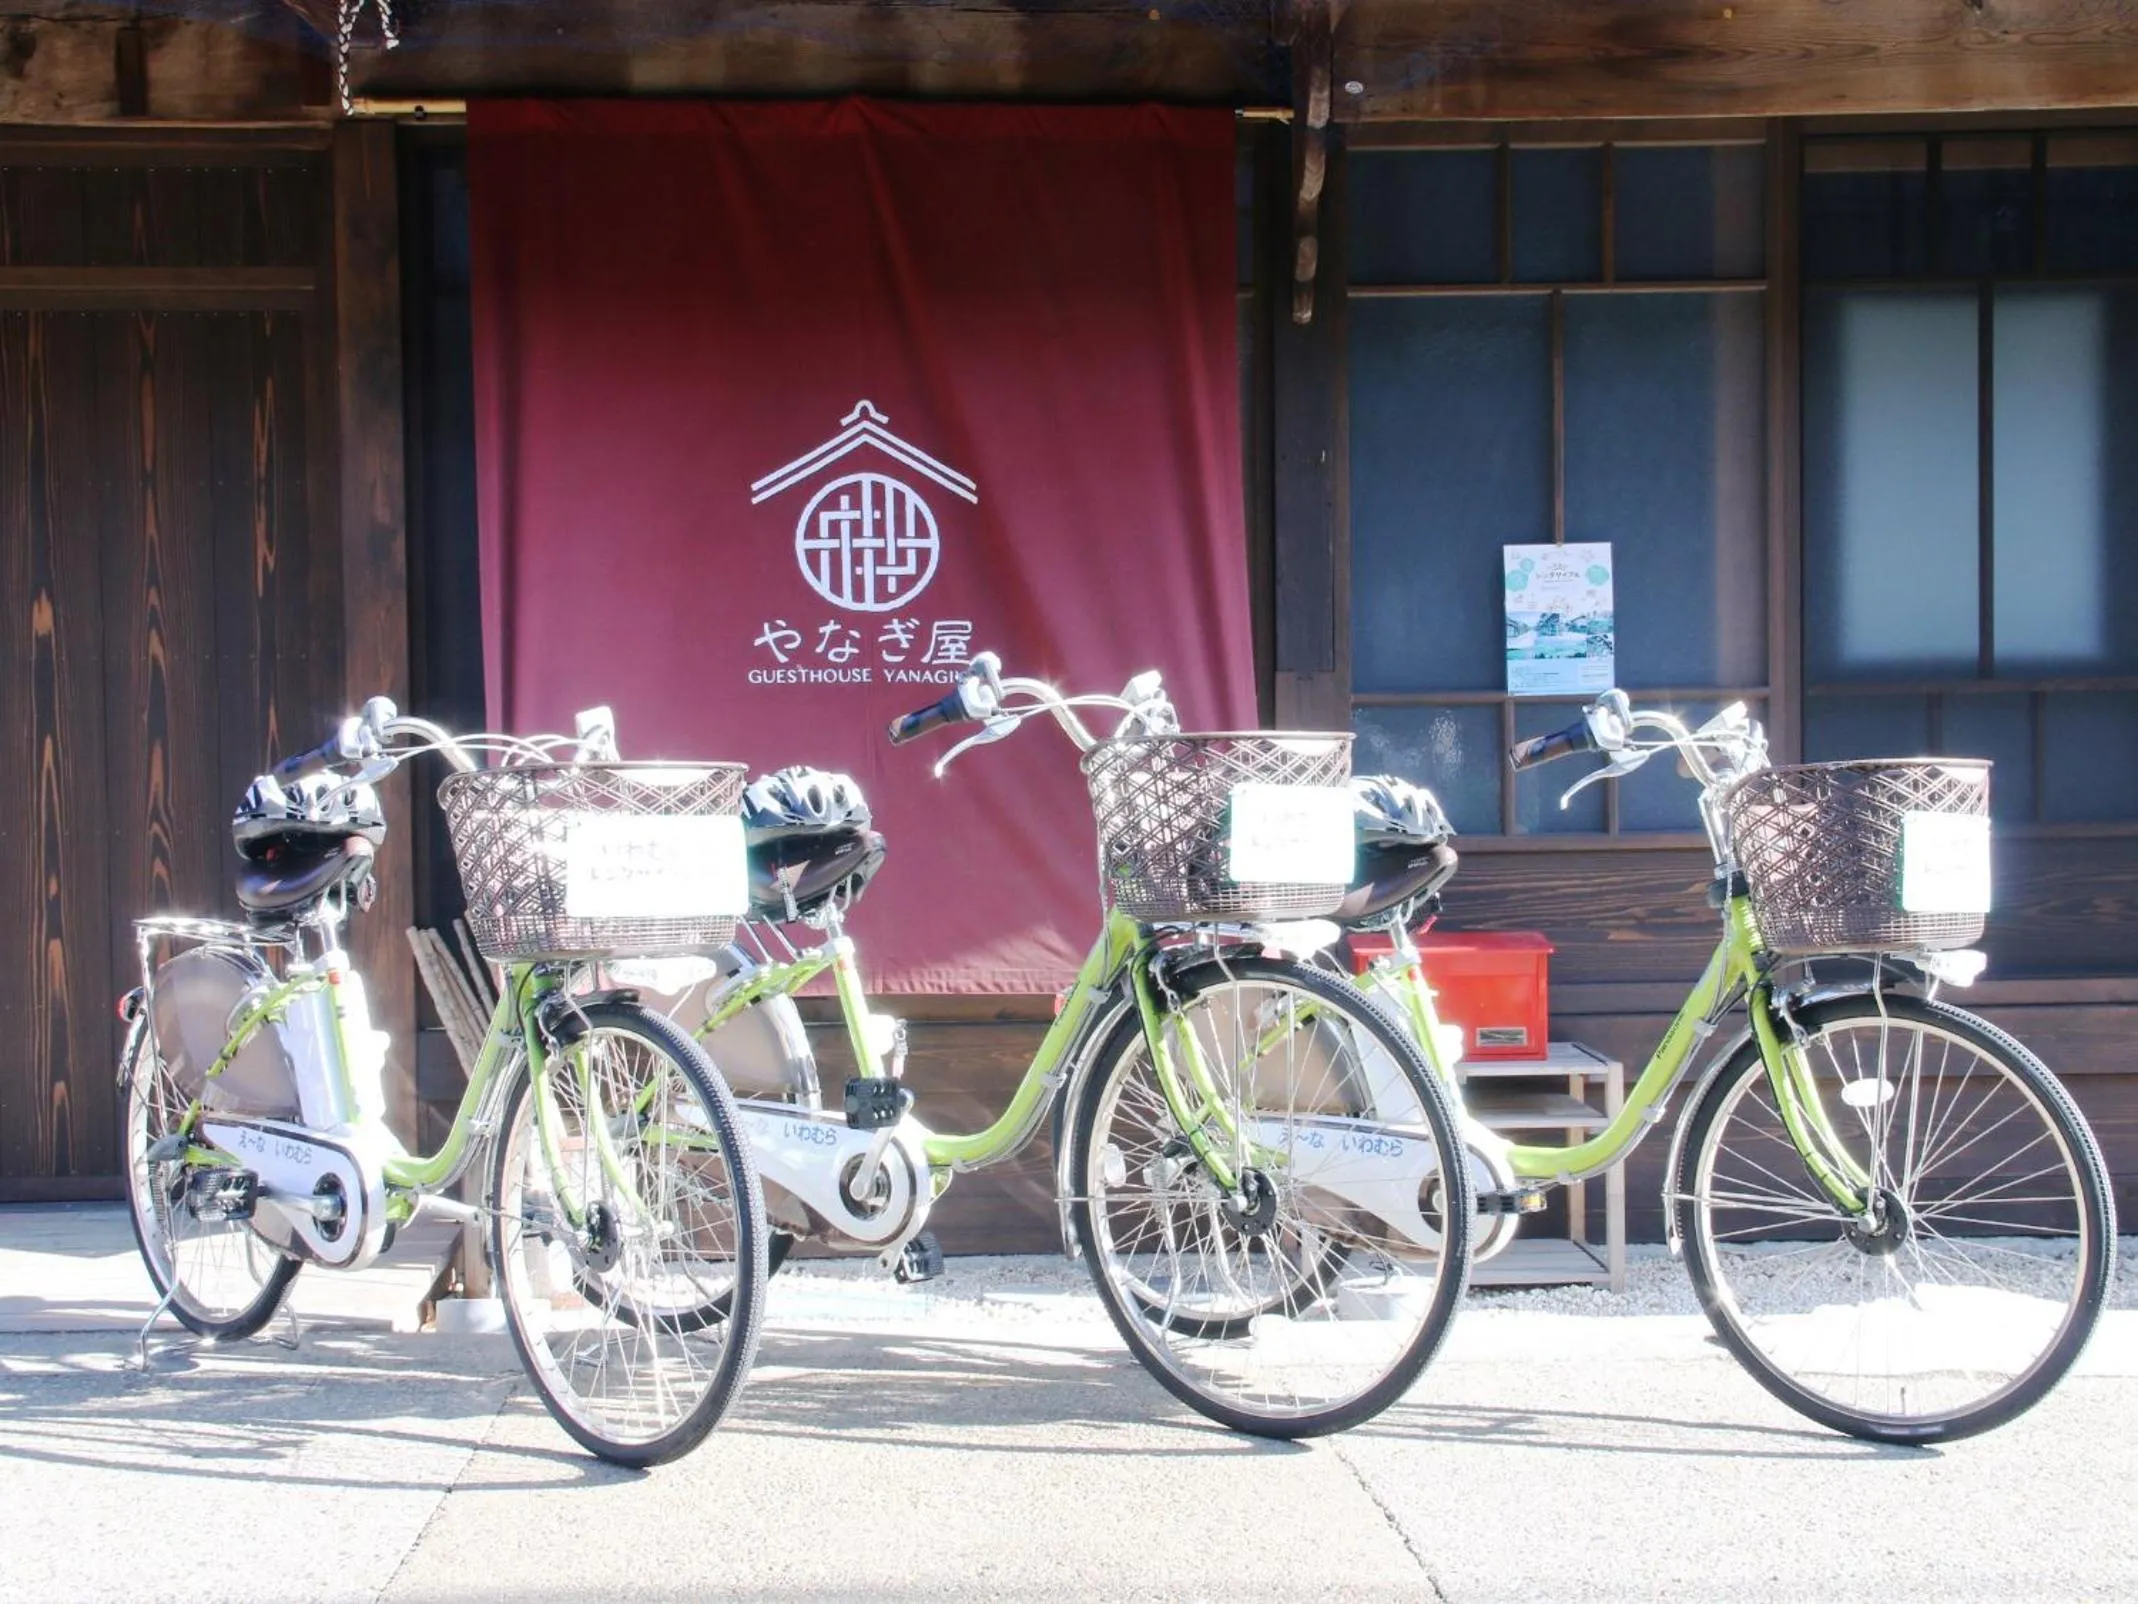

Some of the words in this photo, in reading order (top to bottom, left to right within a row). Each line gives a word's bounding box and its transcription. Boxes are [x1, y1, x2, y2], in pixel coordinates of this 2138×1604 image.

[753, 617, 973, 666] やなぎ屋
[747, 667, 873, 684] GUESTHOUSE
[884, 669, 960, 684] YANAGI
[1341, 1132, 1404, 1157] いわむら
